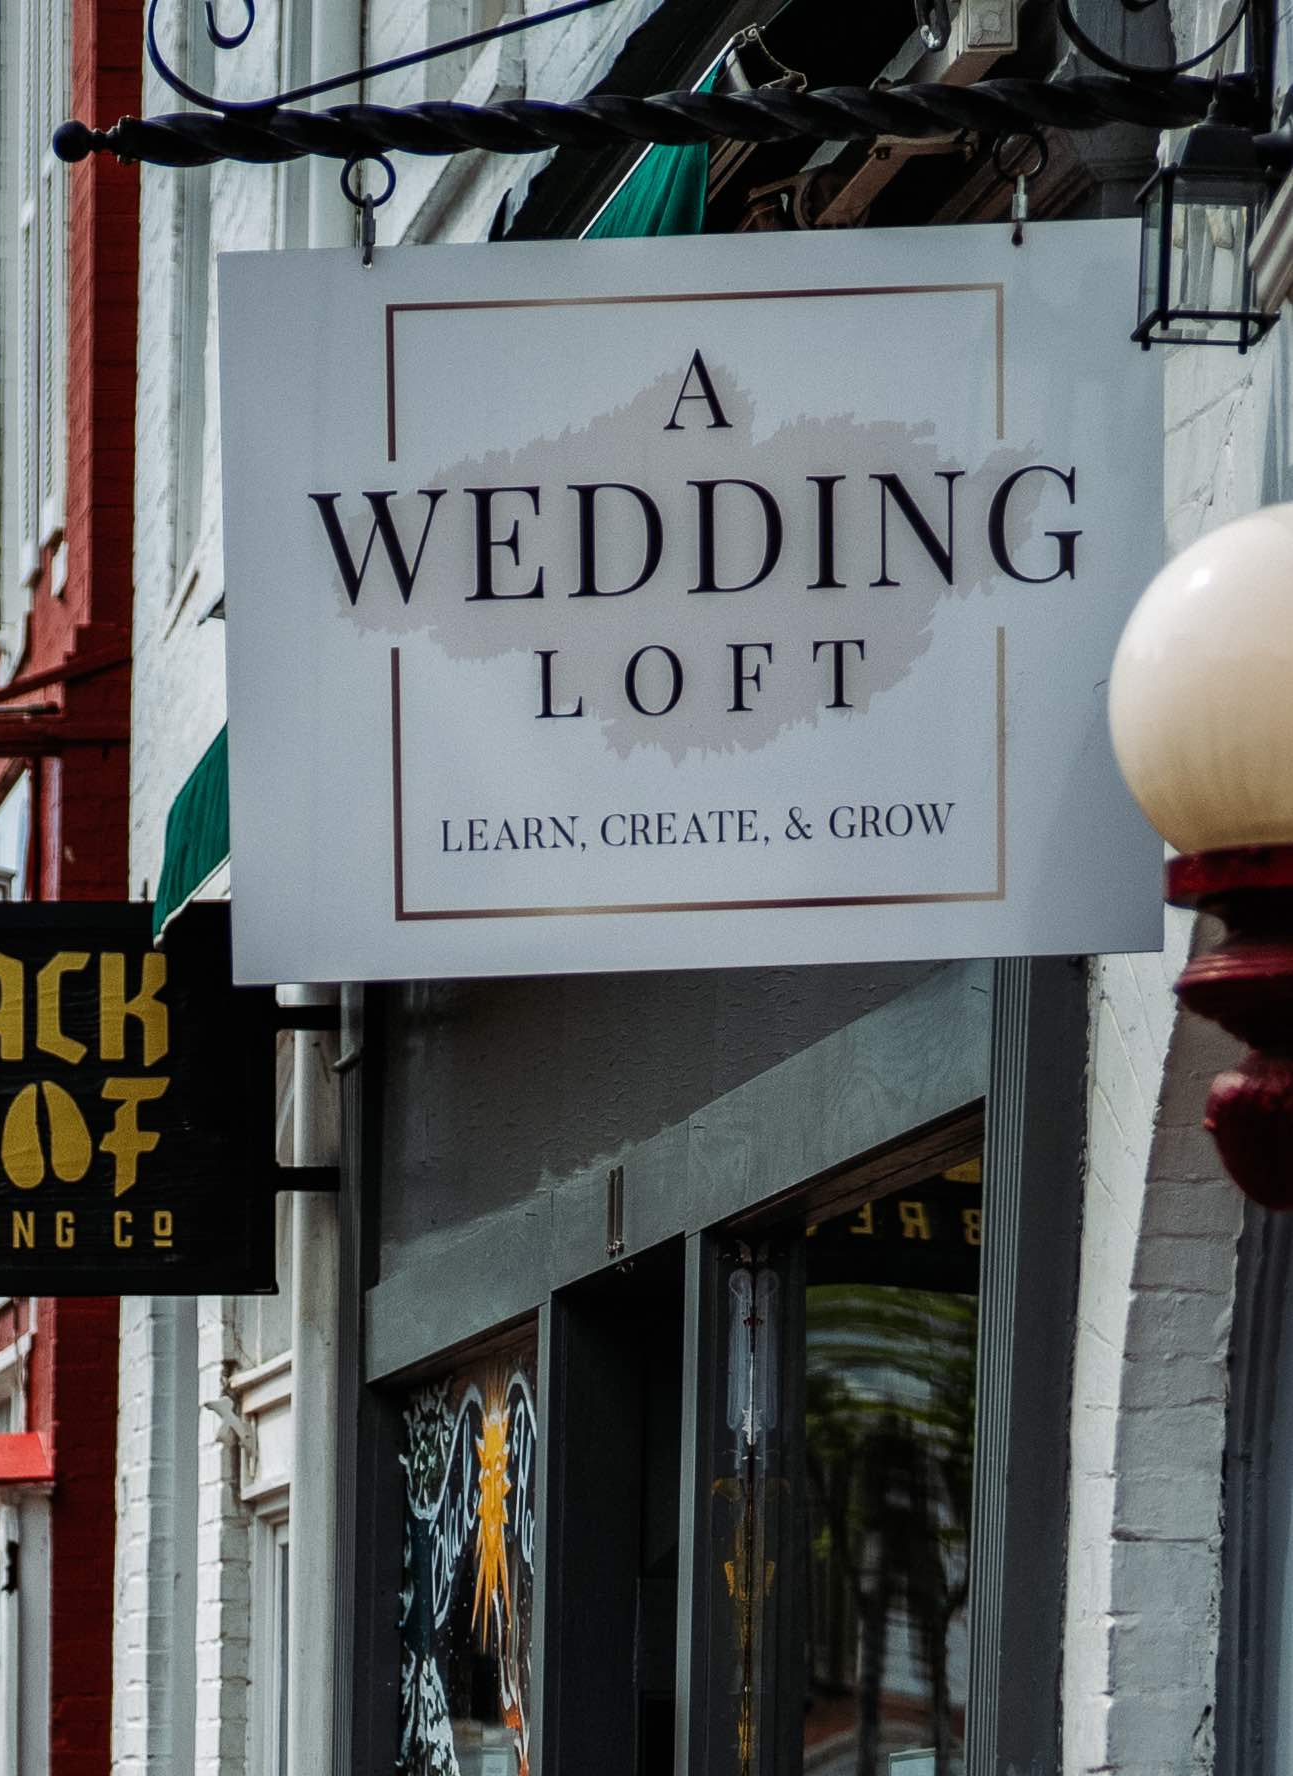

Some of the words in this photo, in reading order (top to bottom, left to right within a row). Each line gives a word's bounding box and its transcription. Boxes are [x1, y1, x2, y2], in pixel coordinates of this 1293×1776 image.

[663, 347, 734, 431] A
[308, 464, 1084, 608] WEDDING
[534, 638, 867, 720] LOFT
[440, 814, 588, 854] LEARN,
[600, 808, 771, 850] CREATE,
[783, 807, 814, 841] &
[828, 801, 956, 840] GROW
